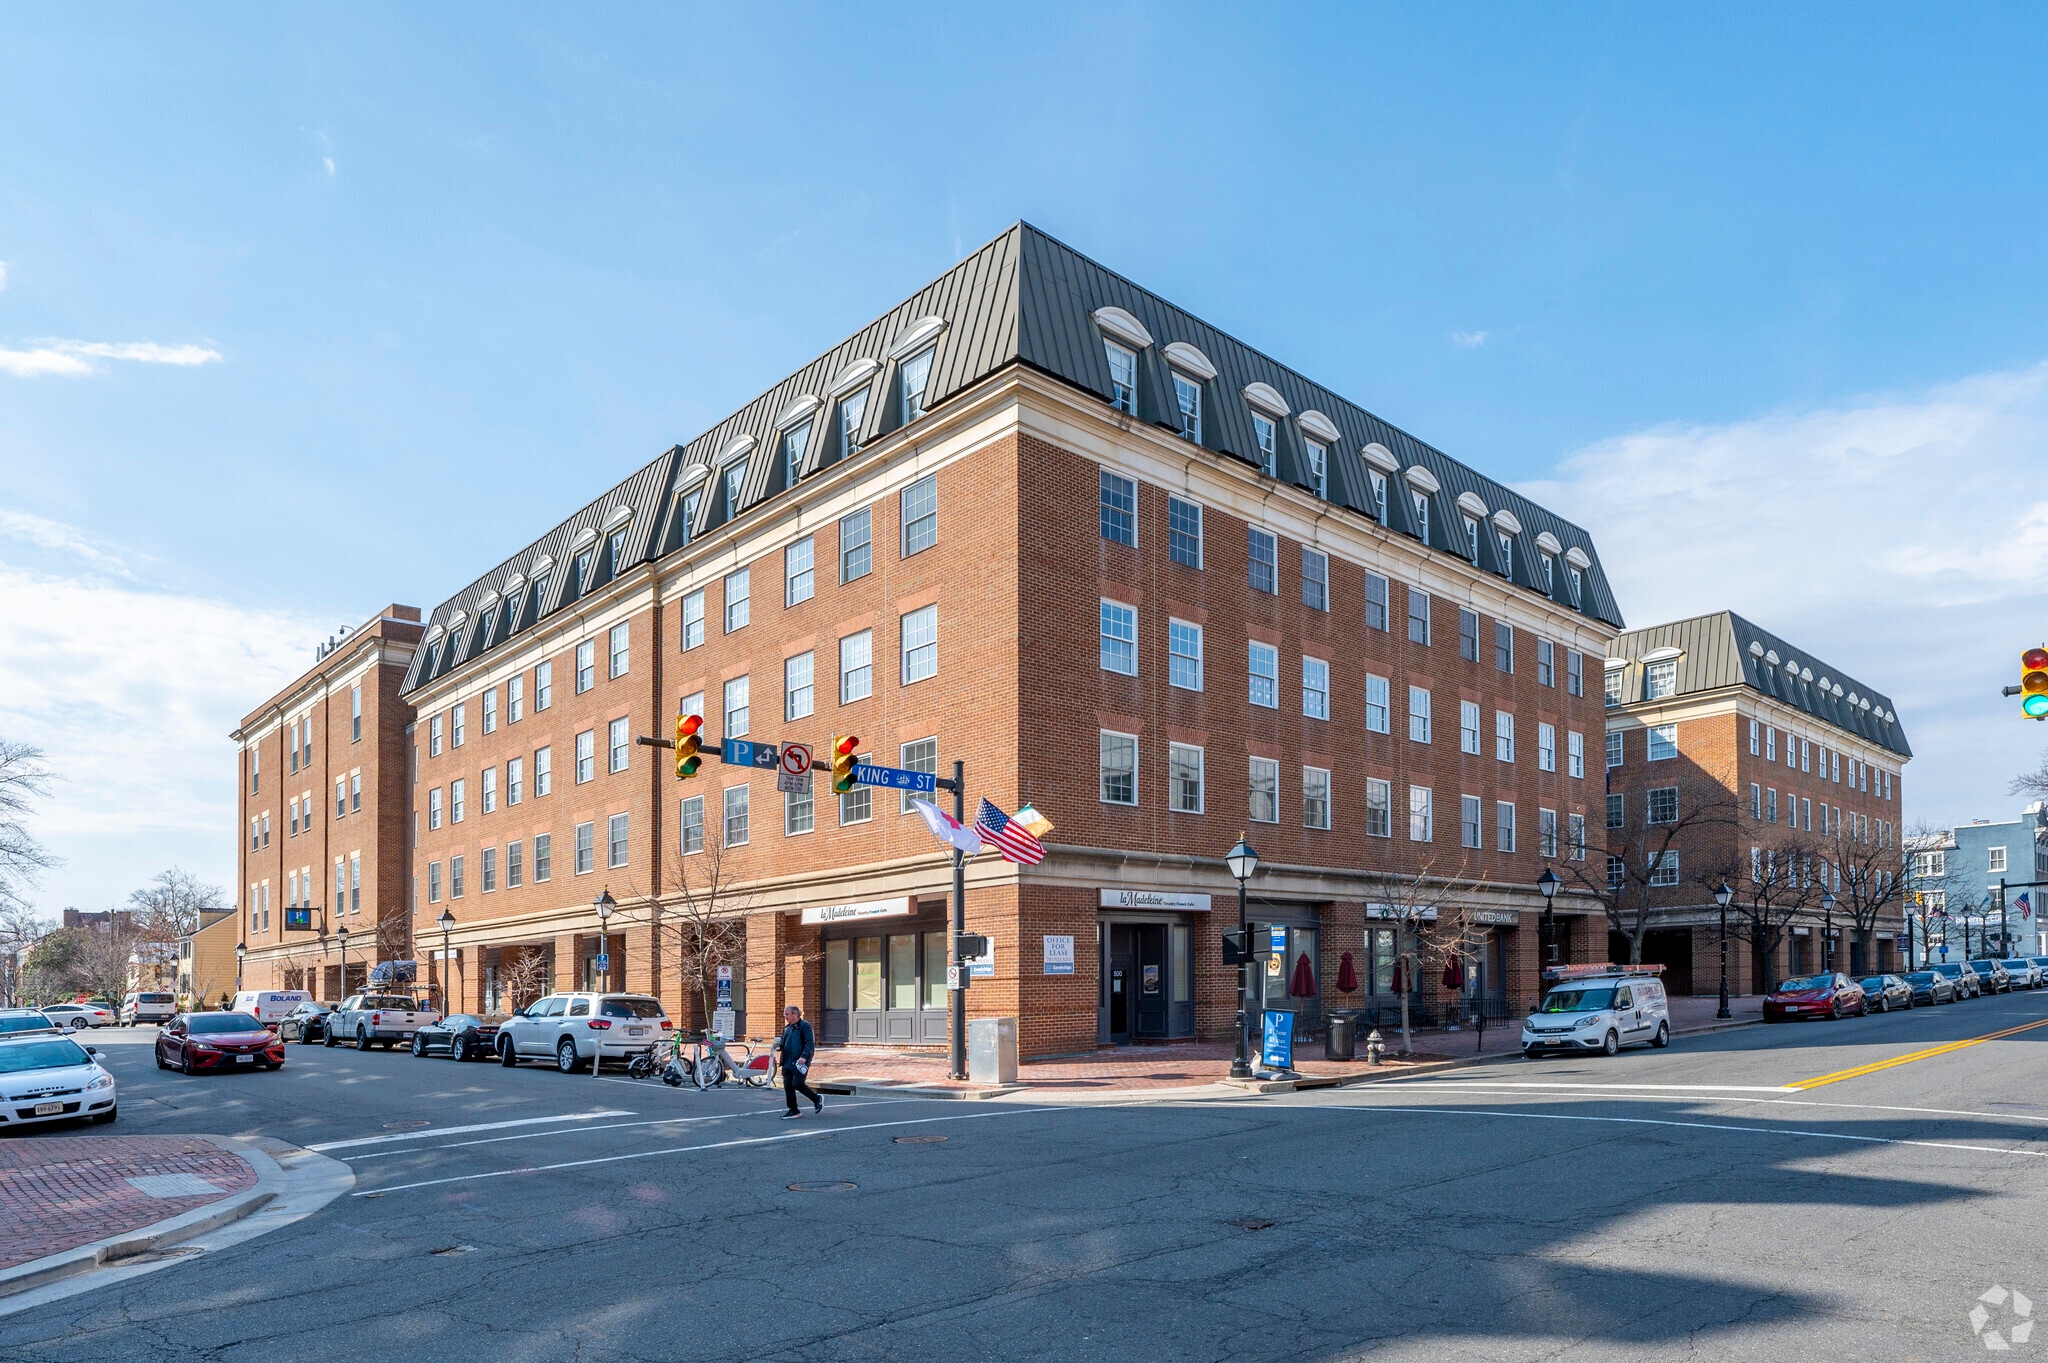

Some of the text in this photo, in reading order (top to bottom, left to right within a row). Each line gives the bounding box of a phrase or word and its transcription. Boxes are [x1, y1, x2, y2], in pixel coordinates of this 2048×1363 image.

[732, 742, 749, 763] P
[857, 766, 932, 790] KING ST
[1496, 913, 1512, 923] BANK
[1275, 1013, 1284, 1028] P
